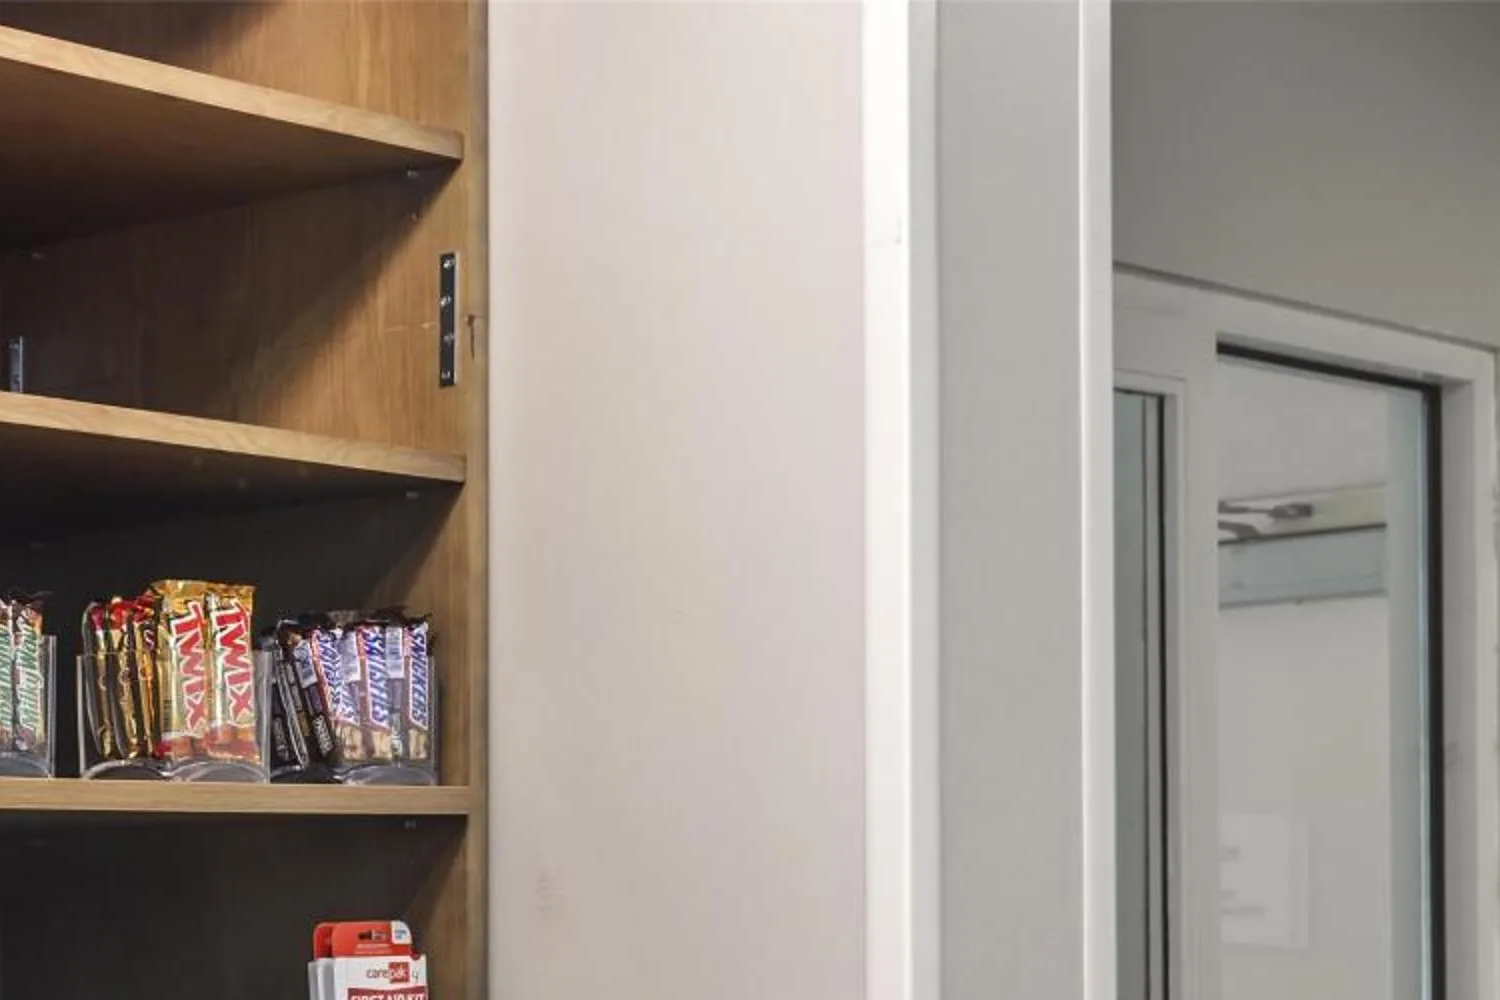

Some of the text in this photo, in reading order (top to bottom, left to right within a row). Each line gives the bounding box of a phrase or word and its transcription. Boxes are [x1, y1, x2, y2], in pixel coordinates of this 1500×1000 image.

[170, 601, 208, 736] TWIX
[211, 598, 253, 727] TWIX
[410, 632, 427, 727] SNICKERS
